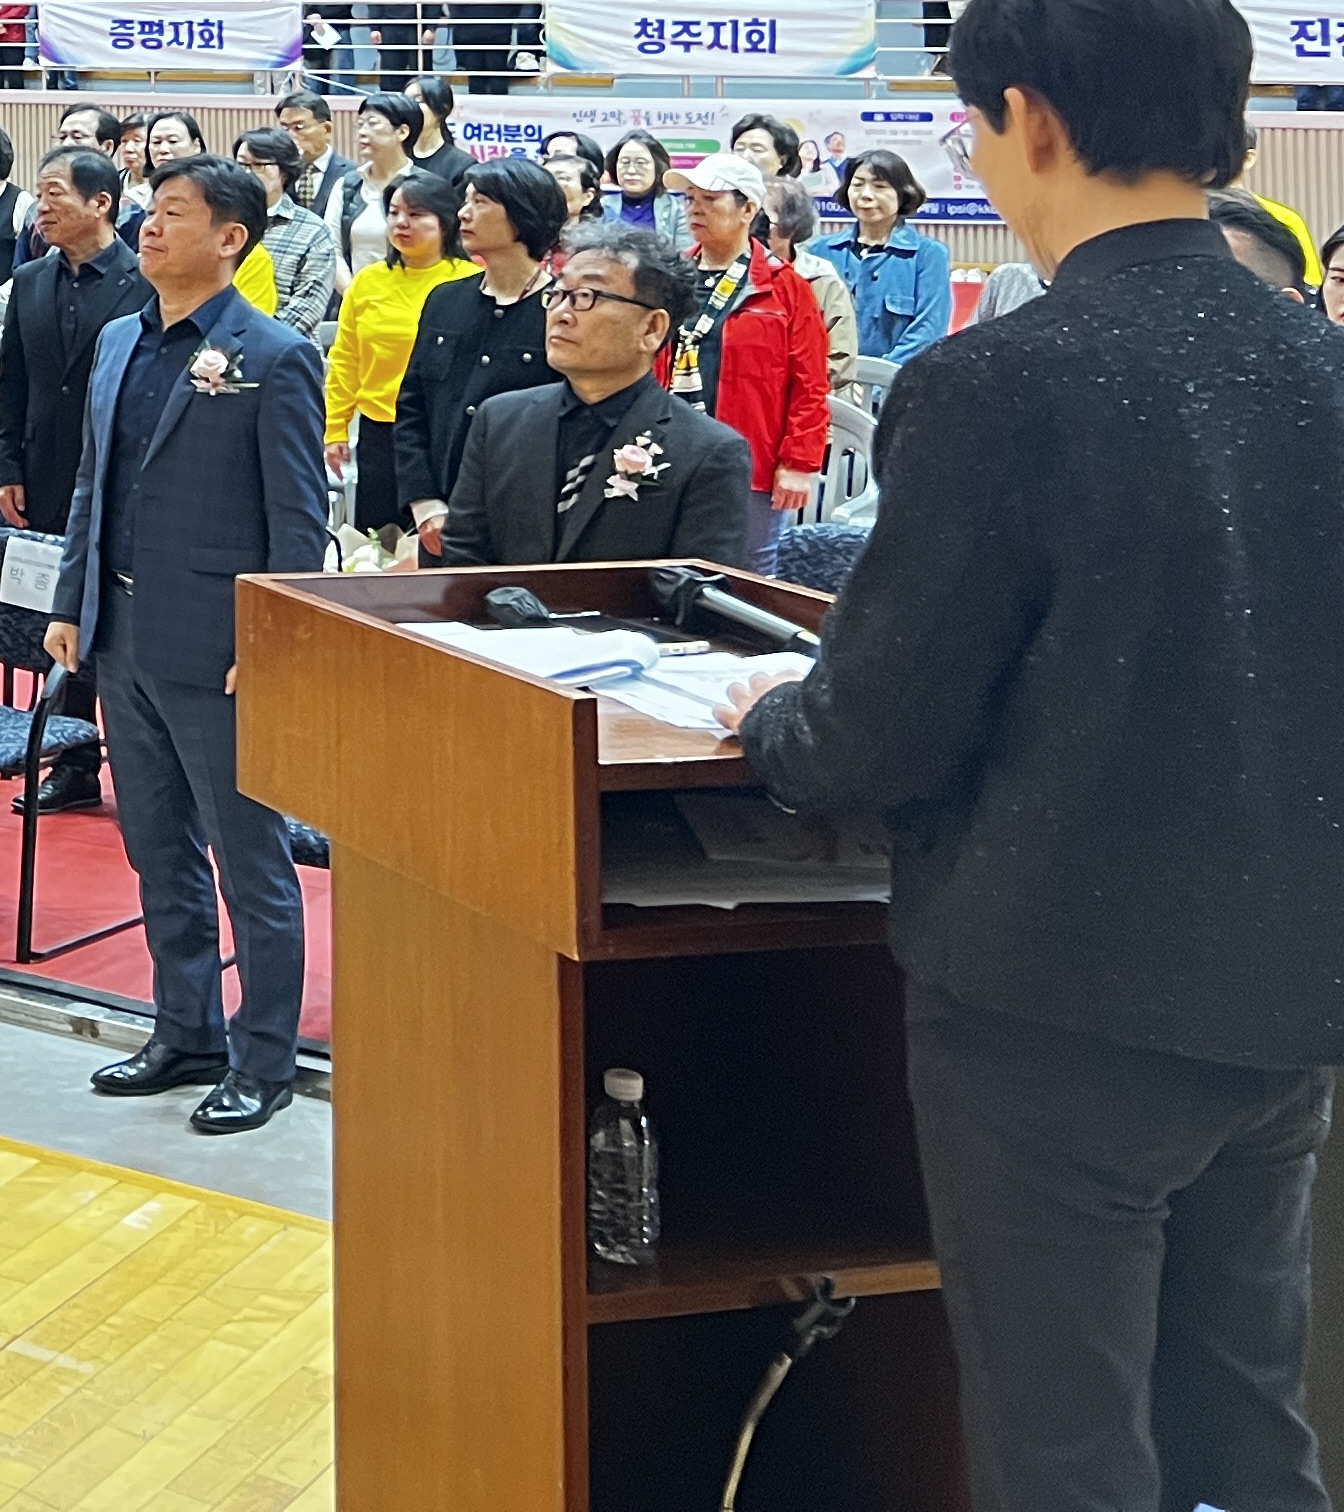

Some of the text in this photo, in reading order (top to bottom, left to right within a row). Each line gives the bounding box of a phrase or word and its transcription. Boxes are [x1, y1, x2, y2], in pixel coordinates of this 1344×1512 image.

[110, 17, 225, 51] 증평지회
[632, 16, 779, 55] 청주지회
[1290, 18, 1344, 57] 진
[463, 123, 543, 143] 여러분의
